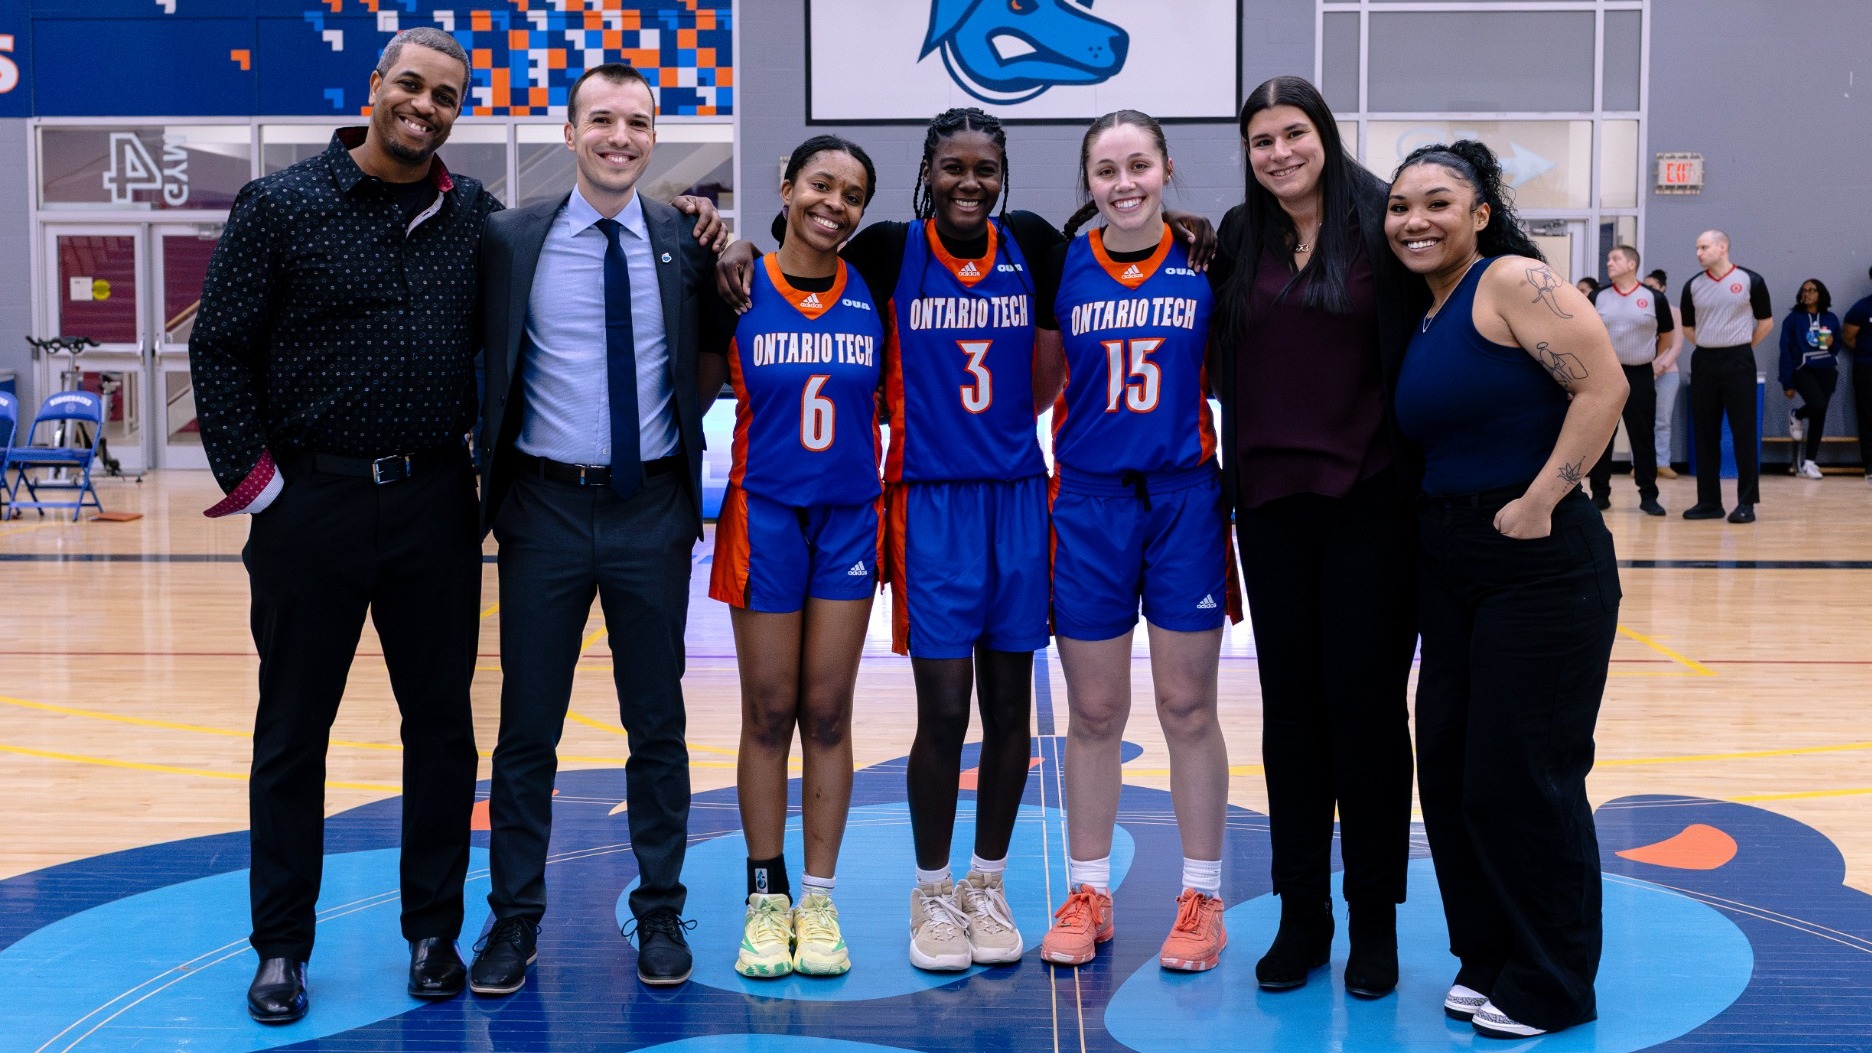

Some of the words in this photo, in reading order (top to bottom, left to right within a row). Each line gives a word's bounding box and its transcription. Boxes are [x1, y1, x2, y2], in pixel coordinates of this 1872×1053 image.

[1165, 267, 1196, 277] OUA
[842, 298, 871, 311] OUA
[909, 297, 989, 331] ONTARIO
[990, 294, 1029, 328] TECH
[1071, 298, 1150, 337] ONTARIO
[1152, 296, 1198, 330] TECH
[753, 332, 833, 367] ONTARIO
[834, 333, 874, 368] TECH
[955, 339, 994, 414] 3
[1100, 337, 1167, 413] 15
[800, 374, 836, 452] 6
